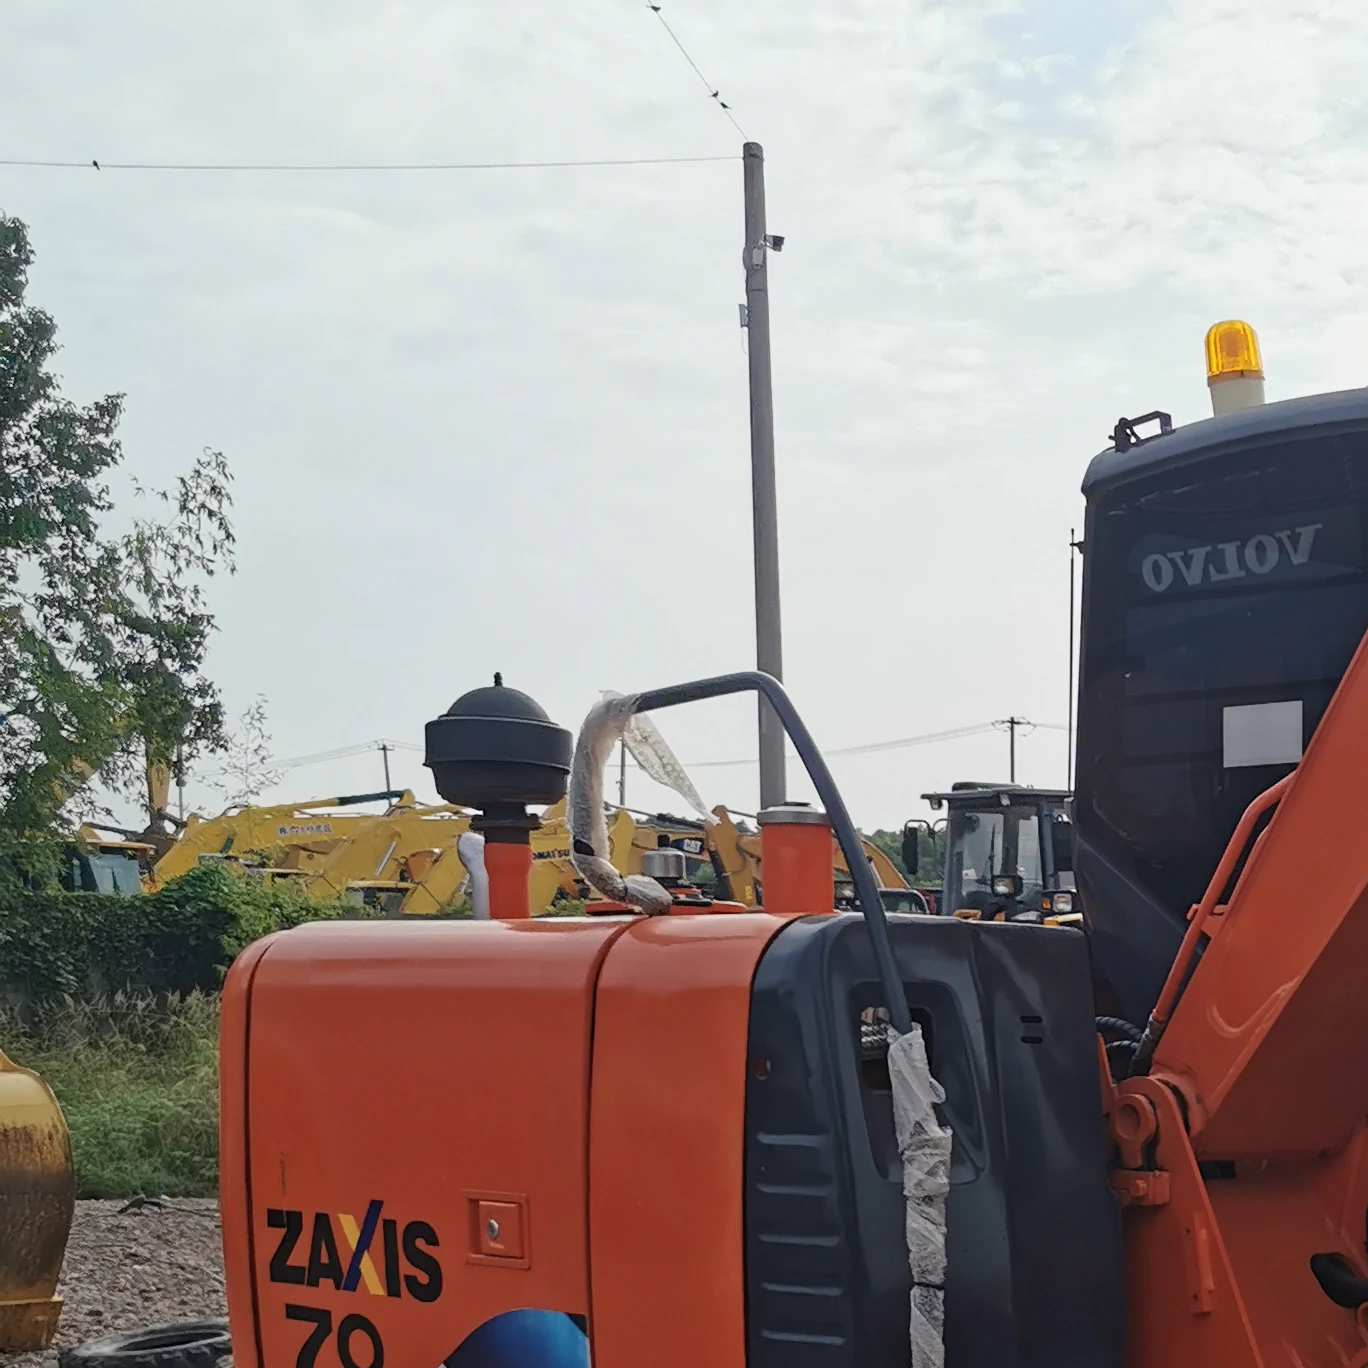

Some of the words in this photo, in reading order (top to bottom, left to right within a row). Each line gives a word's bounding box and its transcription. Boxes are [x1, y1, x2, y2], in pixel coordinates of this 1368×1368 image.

[683, 838, 703, 853] CAT
[532, 848, 570, 860] OMATSU
[266, 1199, 443, 1302] ZAXIS
